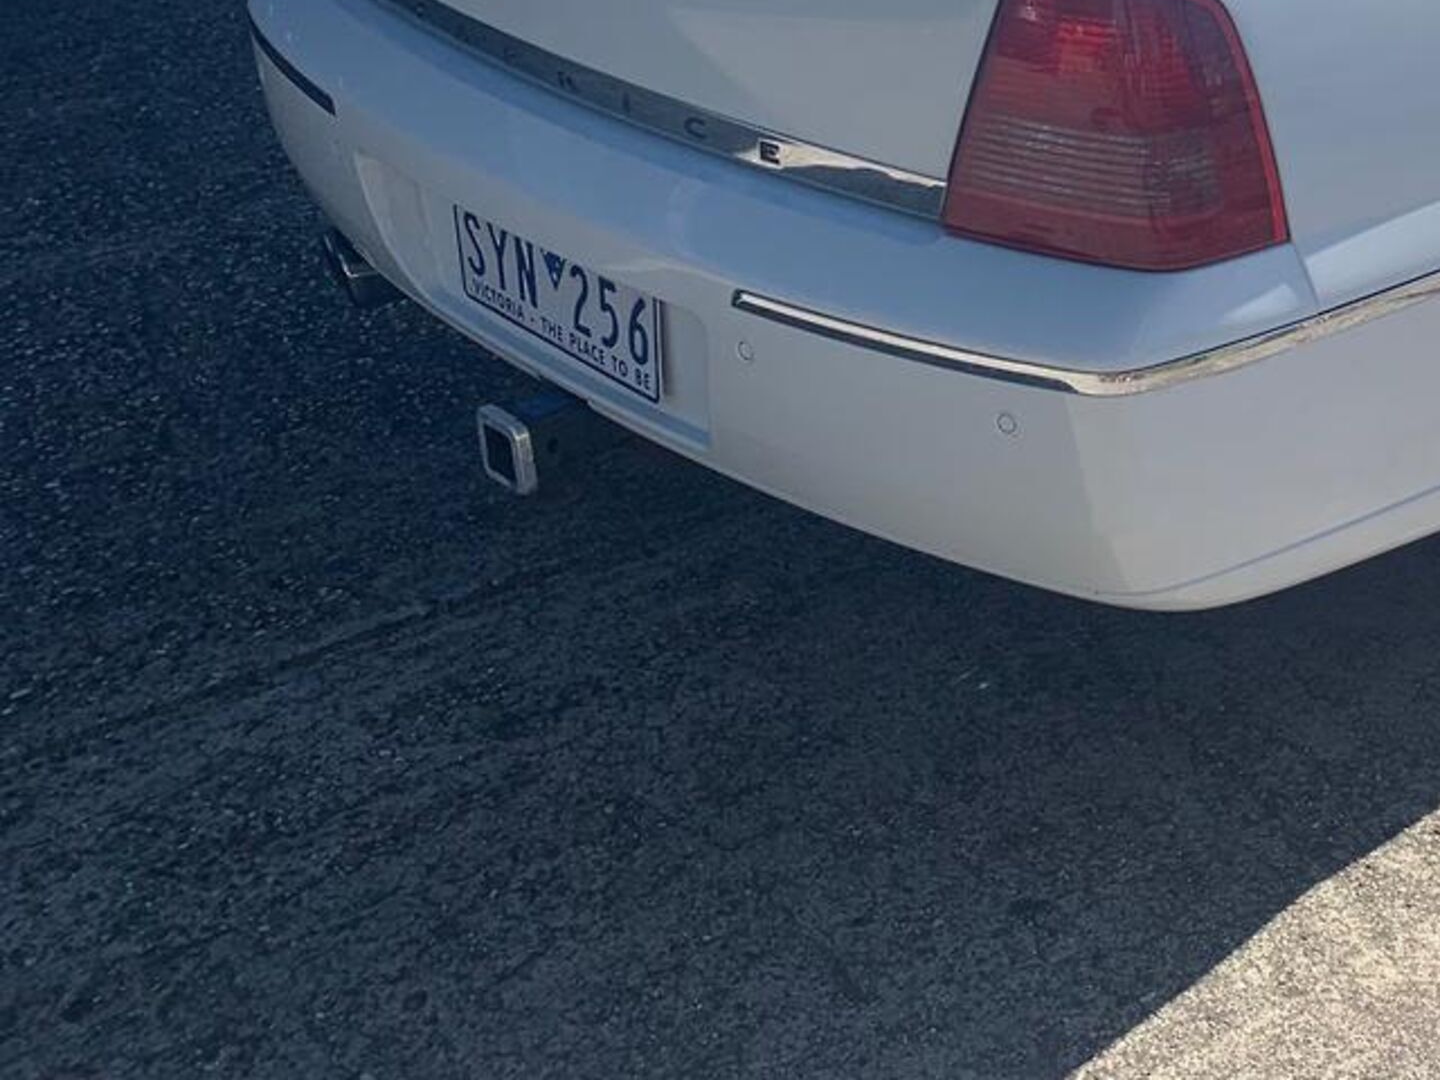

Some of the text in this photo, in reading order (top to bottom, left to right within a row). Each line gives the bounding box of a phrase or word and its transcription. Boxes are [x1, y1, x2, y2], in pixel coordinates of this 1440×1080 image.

[464, 211, 649, 366] SYN 256
[470, 277, 524, 320] VICTORIA
[541, 316, 563, 342] THE
[569, 331, 605, 366] PLACE
[612, 355, 628, 378] TO
[635, 368, 650, 391] BE
